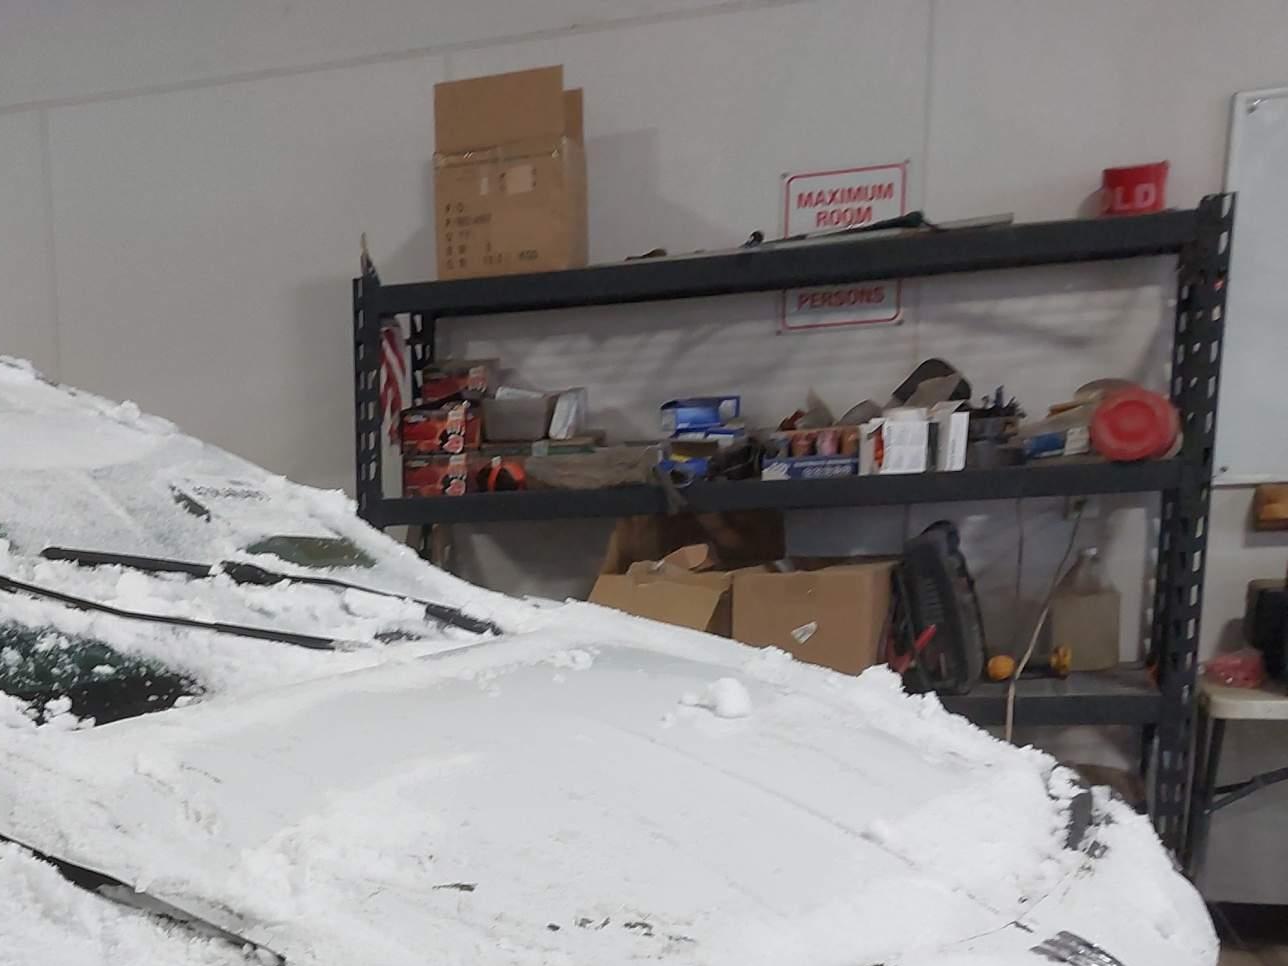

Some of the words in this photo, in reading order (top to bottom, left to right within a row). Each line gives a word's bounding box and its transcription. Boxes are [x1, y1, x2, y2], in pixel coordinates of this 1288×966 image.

[797, 183, 894, 208] MAXIMUM
[816, 207, 873, 227] ROOM
[797, 286, 885, 310] PERSONS
